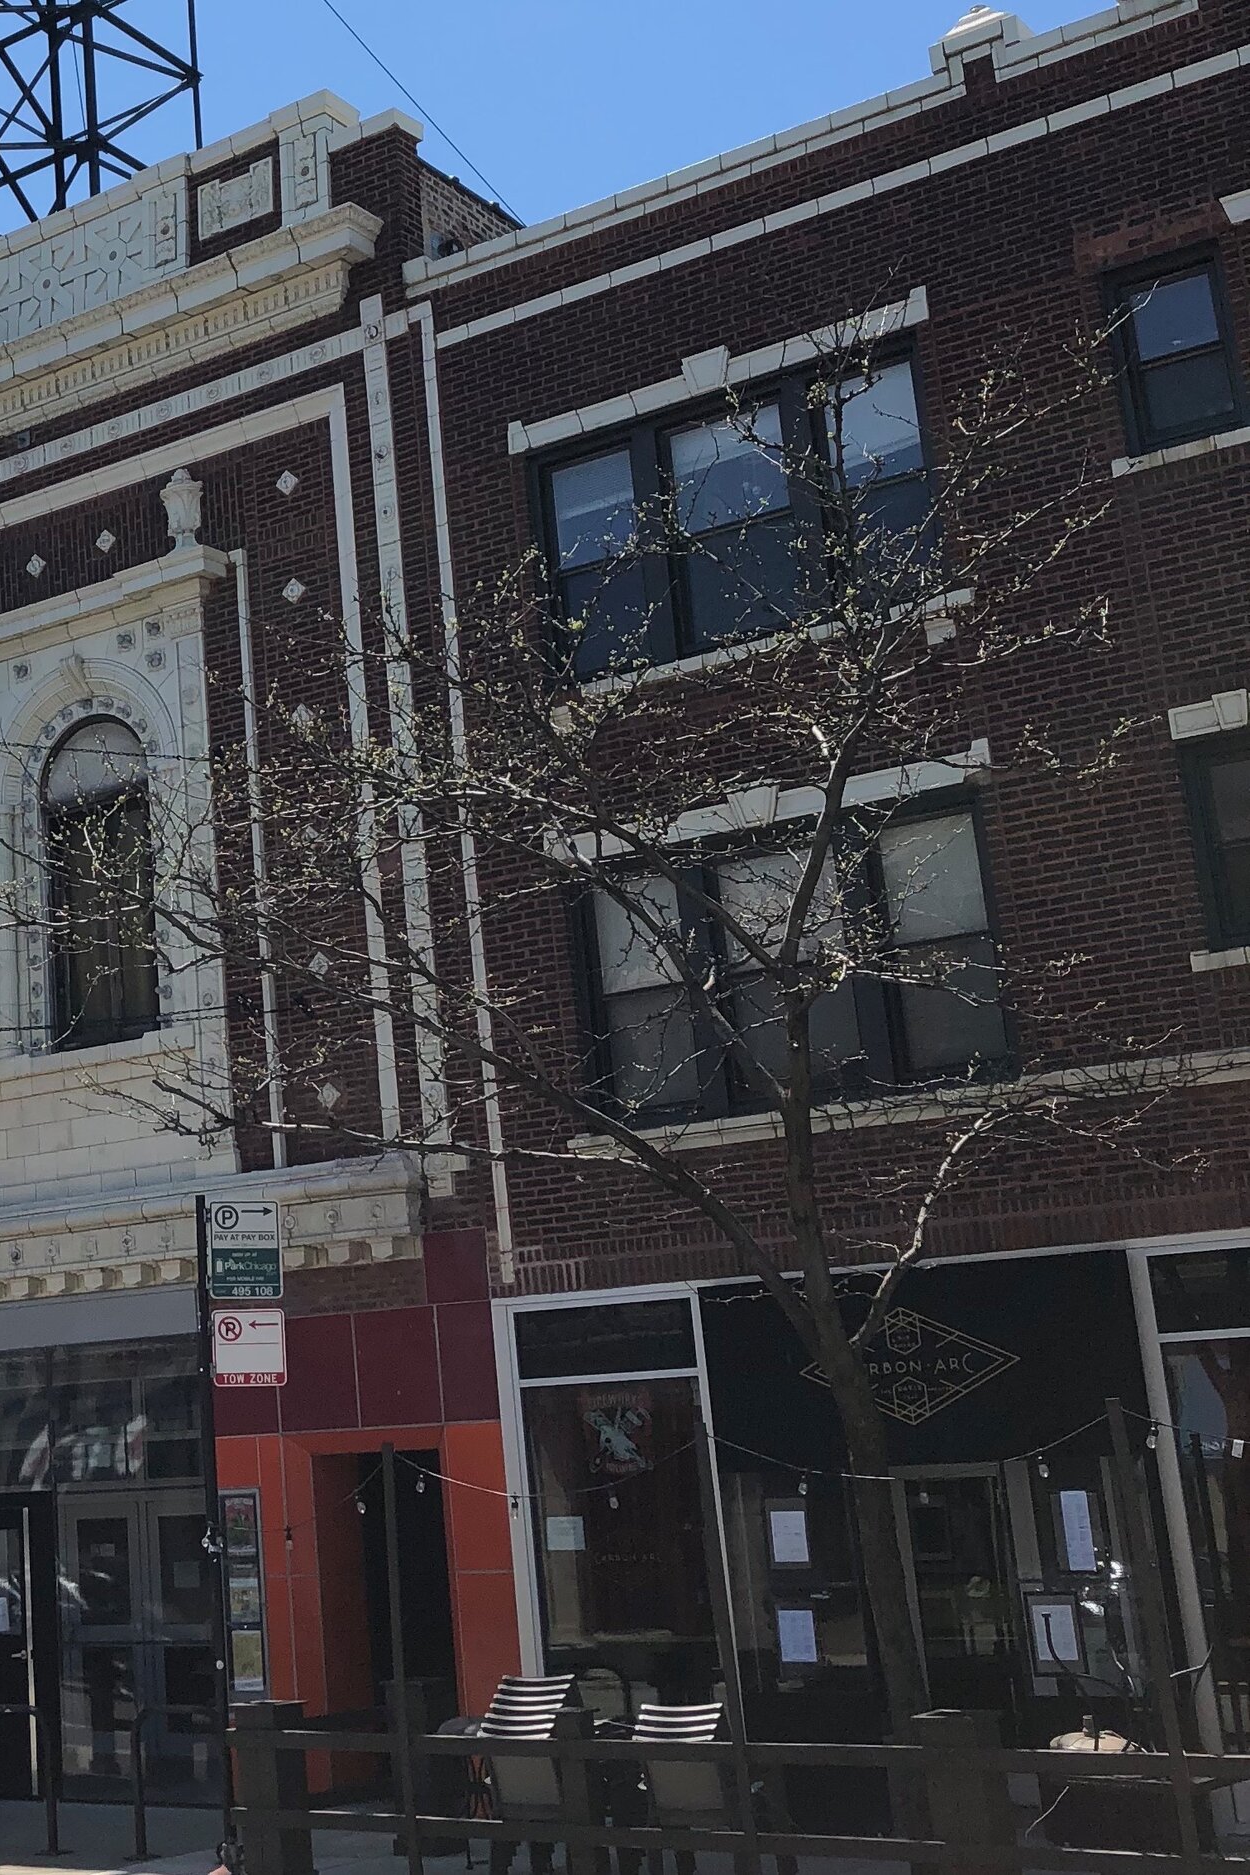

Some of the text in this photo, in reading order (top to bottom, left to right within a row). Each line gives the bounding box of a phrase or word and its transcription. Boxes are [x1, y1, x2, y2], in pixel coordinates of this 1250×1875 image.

[232, 1287, 252, 1296] 495
[255, 1287, 274, 1296] 108
[934, 1353, 975, 1375] ARC
[223, 1373, 278, 1384] TOW ZONE
